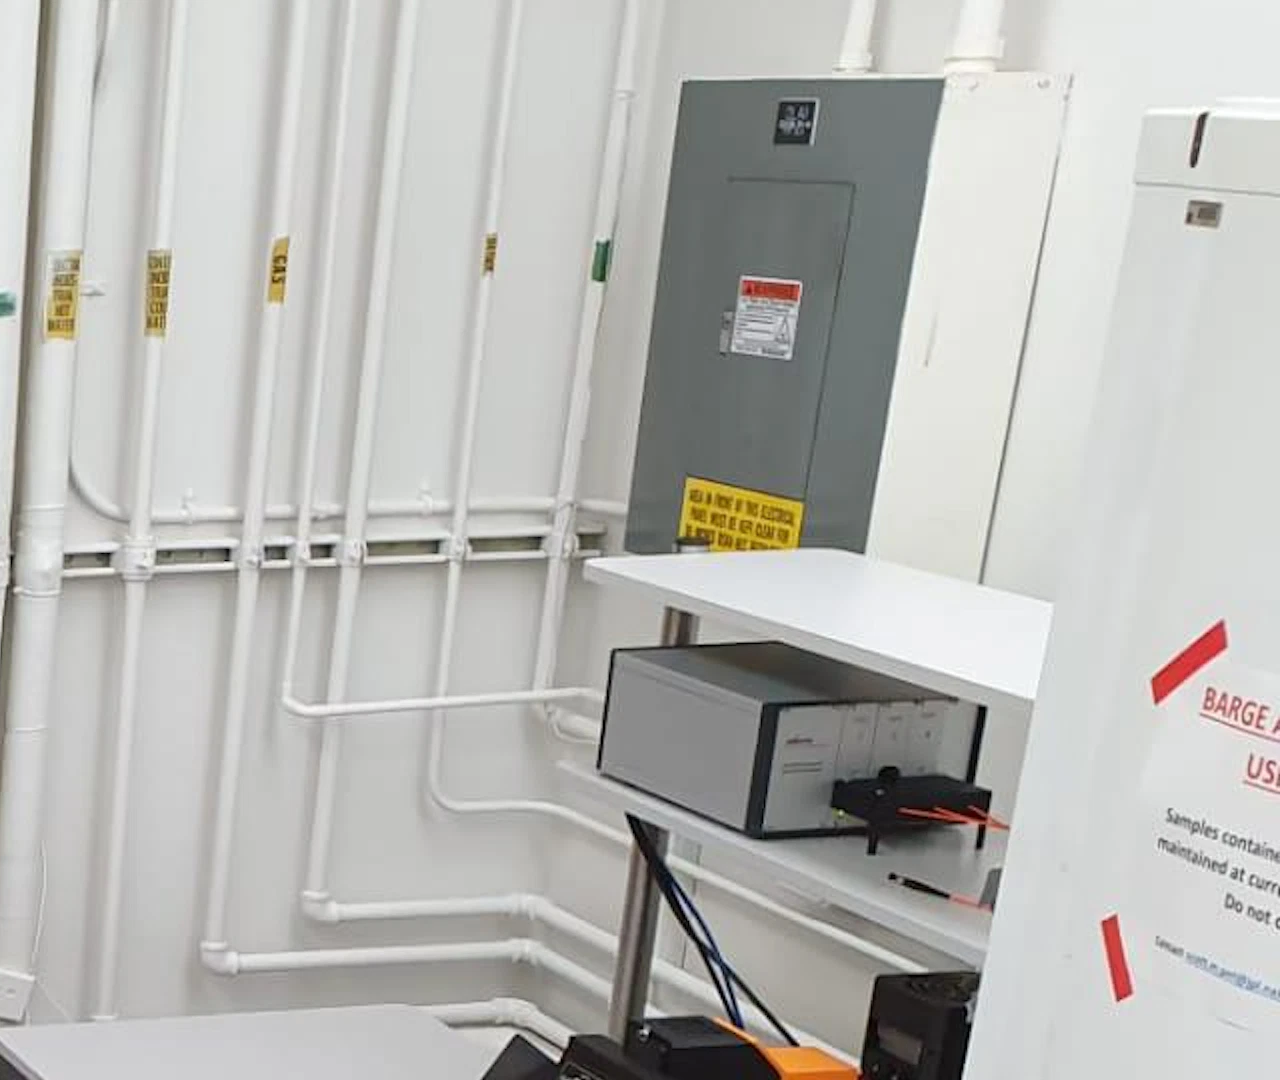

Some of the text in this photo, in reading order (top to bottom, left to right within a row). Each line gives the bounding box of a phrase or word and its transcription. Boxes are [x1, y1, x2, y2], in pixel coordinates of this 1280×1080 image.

[272, 255, 288, 284] GAS
[1202, 686, 1271, 731] BARGE
[1247, 752, 1280, 787] US
[1165, 807, 1219, 841] Samples
[1157, 837, 1229, 876] maintained
[1229, 866, 1246, 884] at
[1224, 892, 1244, 914] Do
[1247, 903, 1272, 926] not
